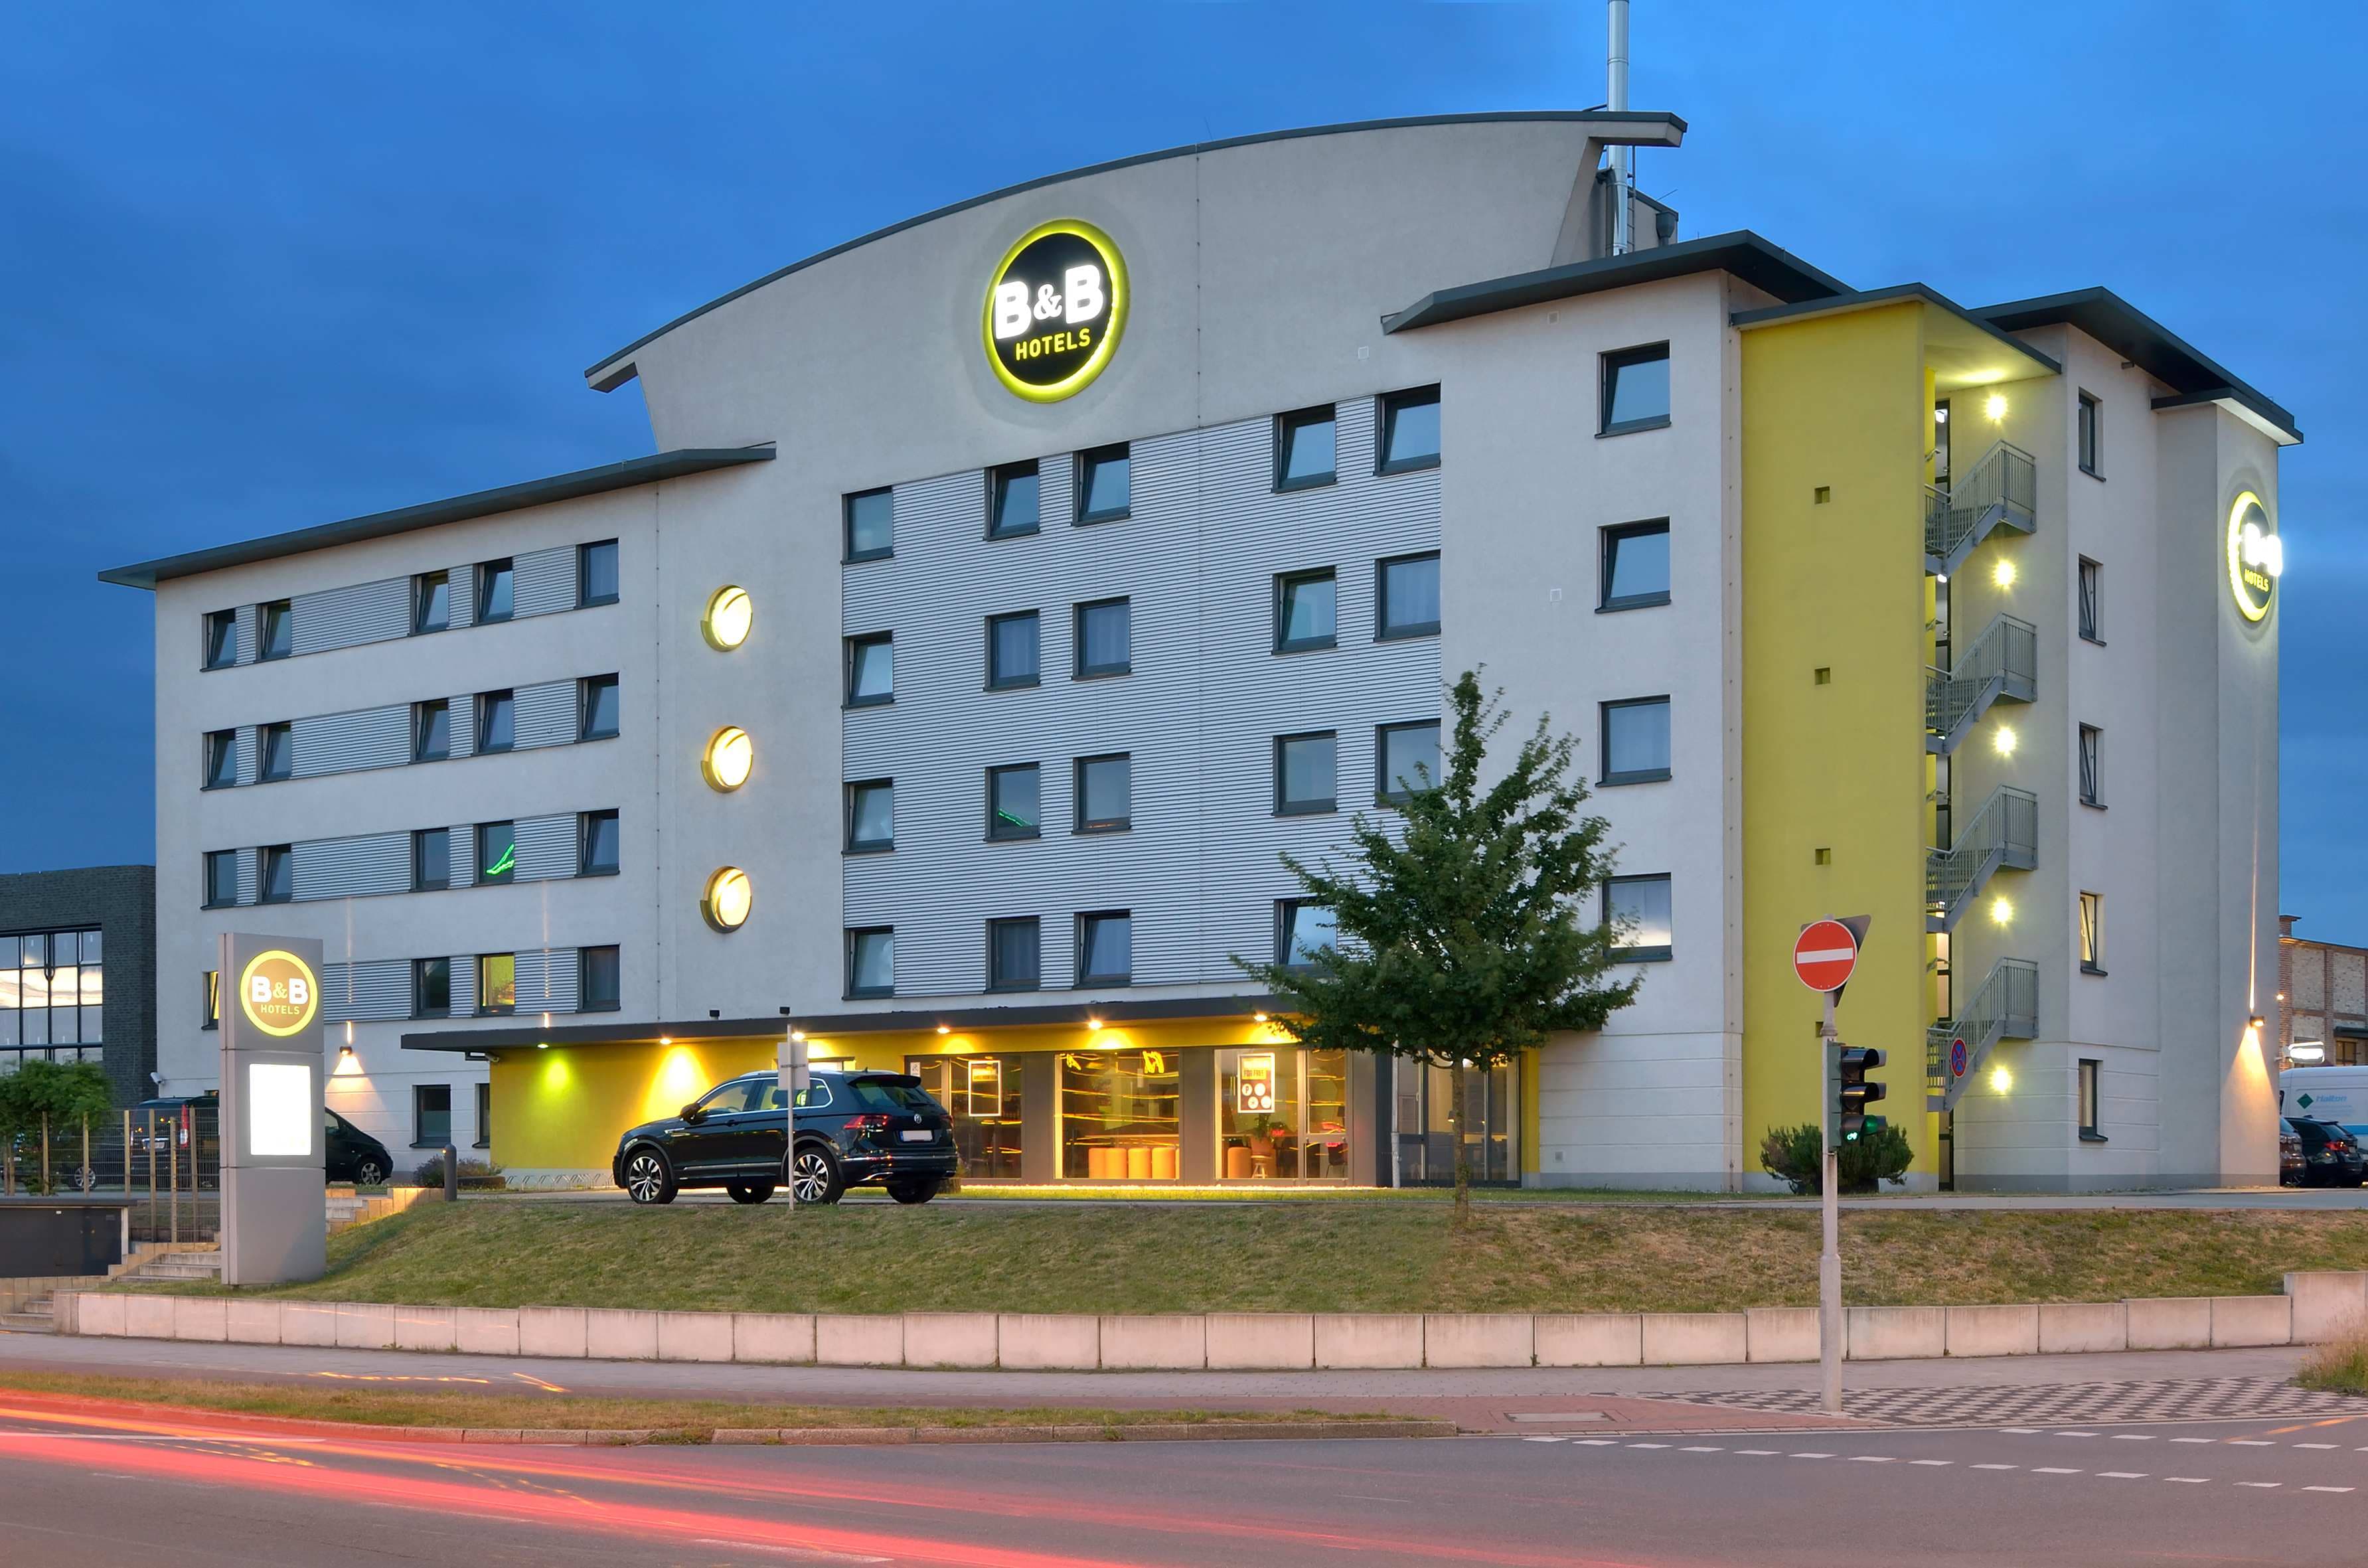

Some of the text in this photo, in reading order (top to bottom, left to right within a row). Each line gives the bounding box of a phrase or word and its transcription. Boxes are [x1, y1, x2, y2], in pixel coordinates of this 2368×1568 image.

[995, 264, 1104, 340] B&B
[1015, 328, 1091, 360] HOTELS
[2245, 568, 2269, 592] HOTELS
[252, 976, 309, 1004] B&B
[260, 1004, 300, 1015] HOTELS
